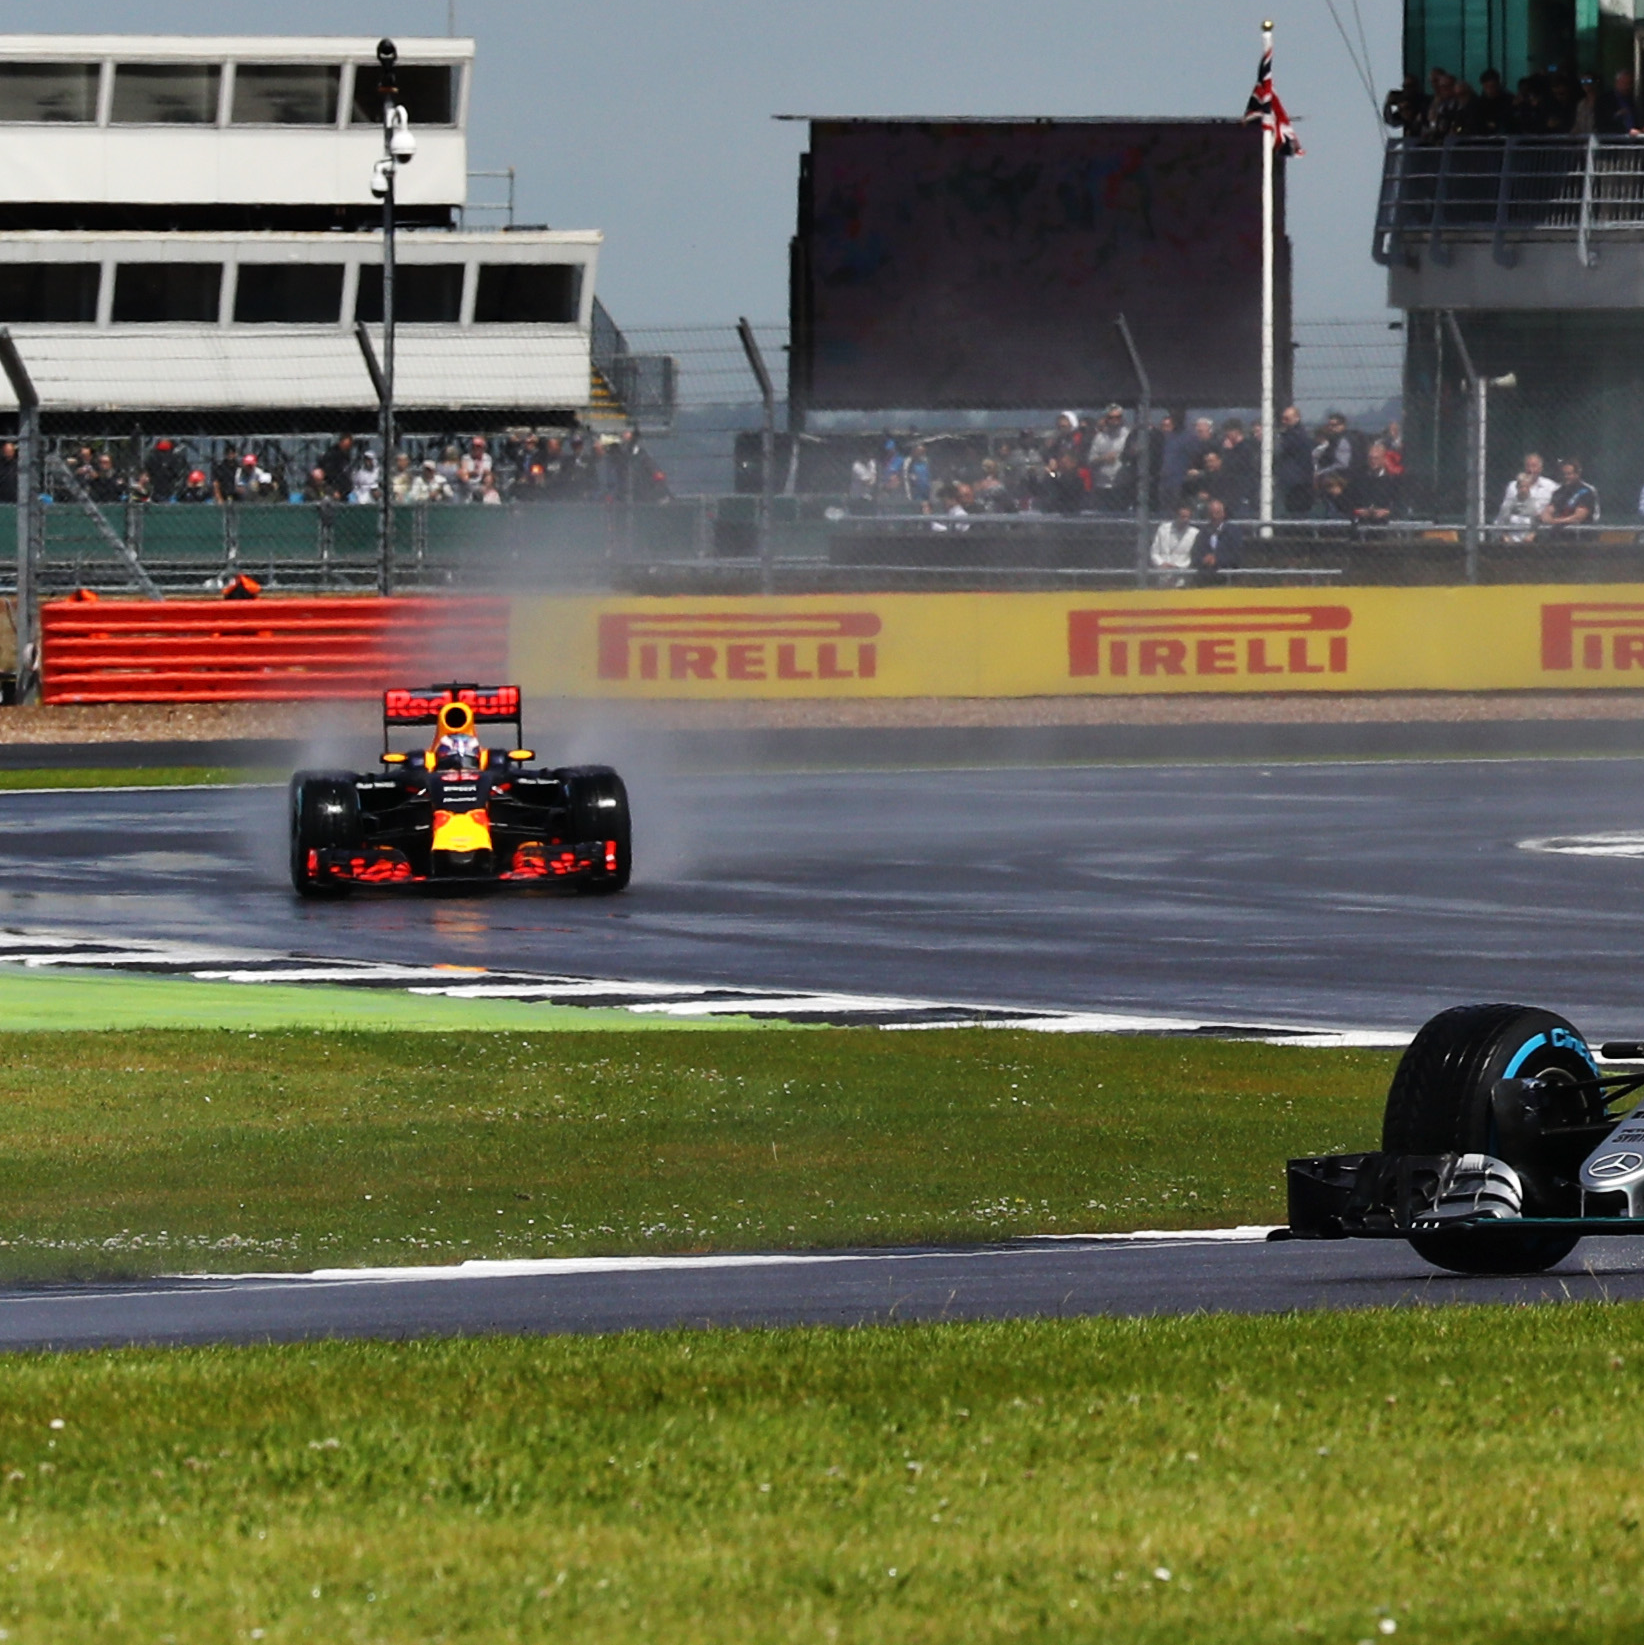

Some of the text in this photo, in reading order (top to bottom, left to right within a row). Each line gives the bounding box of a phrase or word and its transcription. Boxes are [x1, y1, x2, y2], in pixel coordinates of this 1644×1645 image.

[600, 612, 882, 680] PIRELLI
[1068, 606, 1353, 677] PIRELLI
[386, 686, 519, 717] Red Bull
